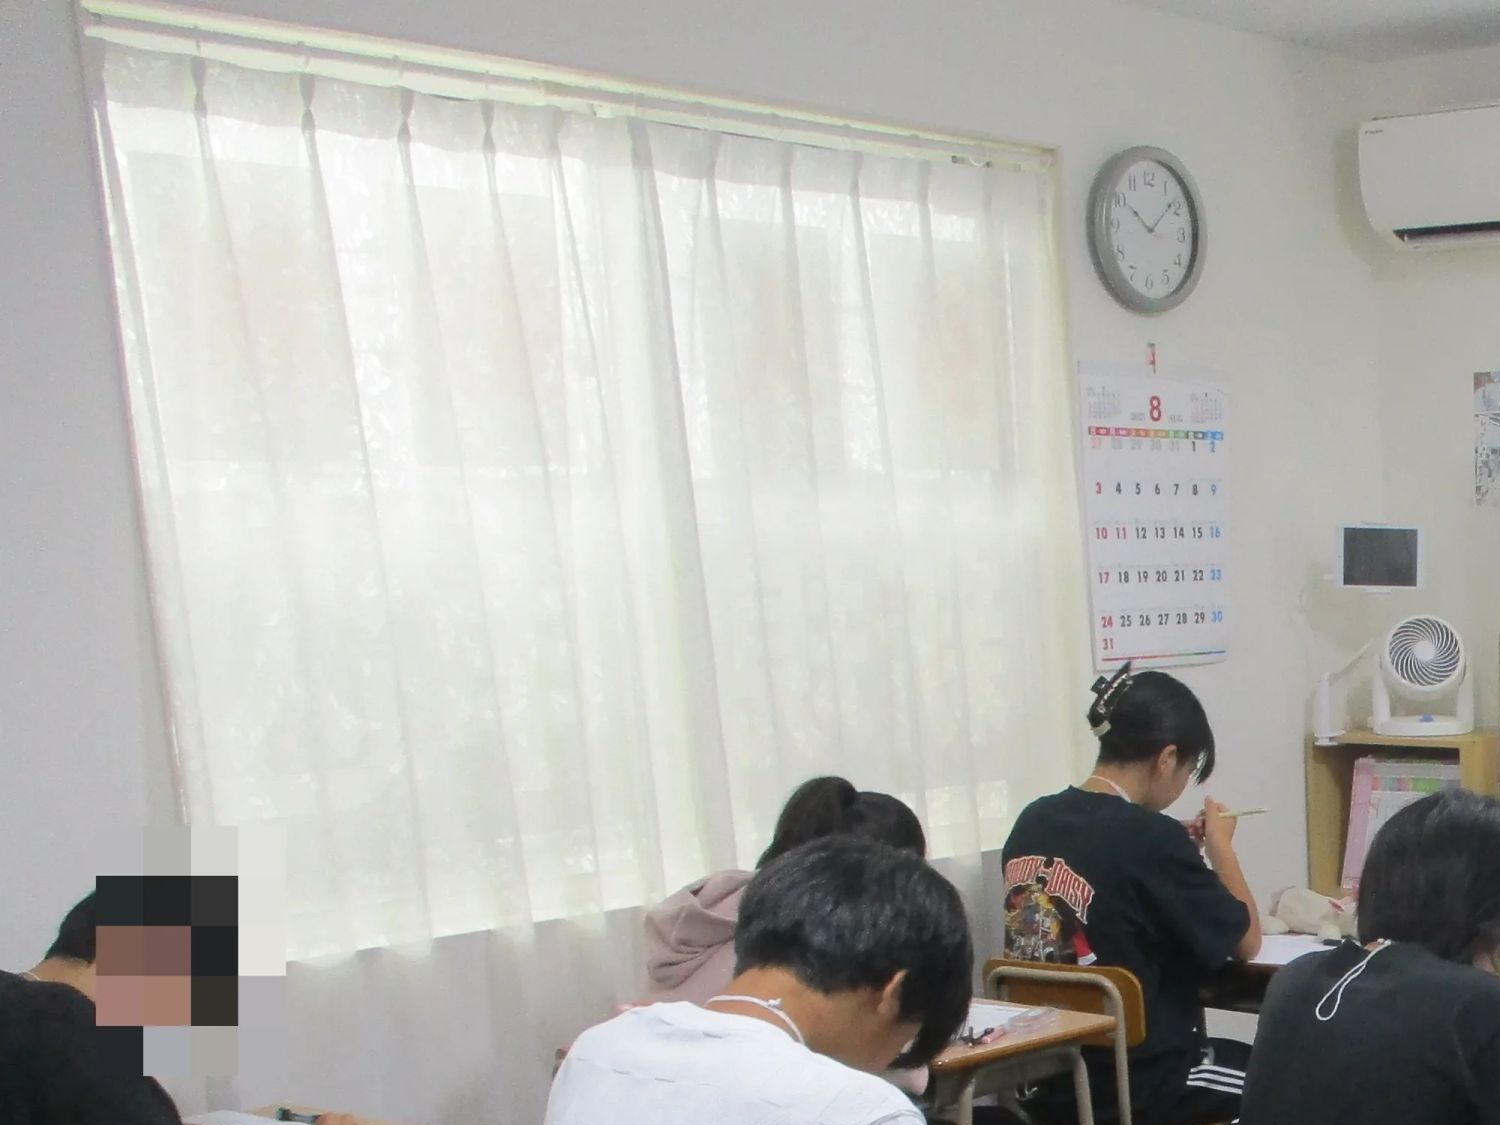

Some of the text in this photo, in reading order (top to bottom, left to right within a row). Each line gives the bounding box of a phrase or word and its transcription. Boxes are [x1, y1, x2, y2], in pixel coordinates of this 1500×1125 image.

[1150, 395, 1161, 422] 8
[1191, 441, 1196, 453] 1
[1210, 441, 1216, 453] 2
[1096, 482, 1217, 496] 3 4 5 6 7 8 9
[1095, 526, 1221, 540] 10 11 12 13 14 15 16
[1098, 569, 1221, 584] 17 18 19 20 21 22 23
[1101, 611, 1223, 628] 24 25 26 27 28 29 30
[1102, 638, 1114, 650] 31
